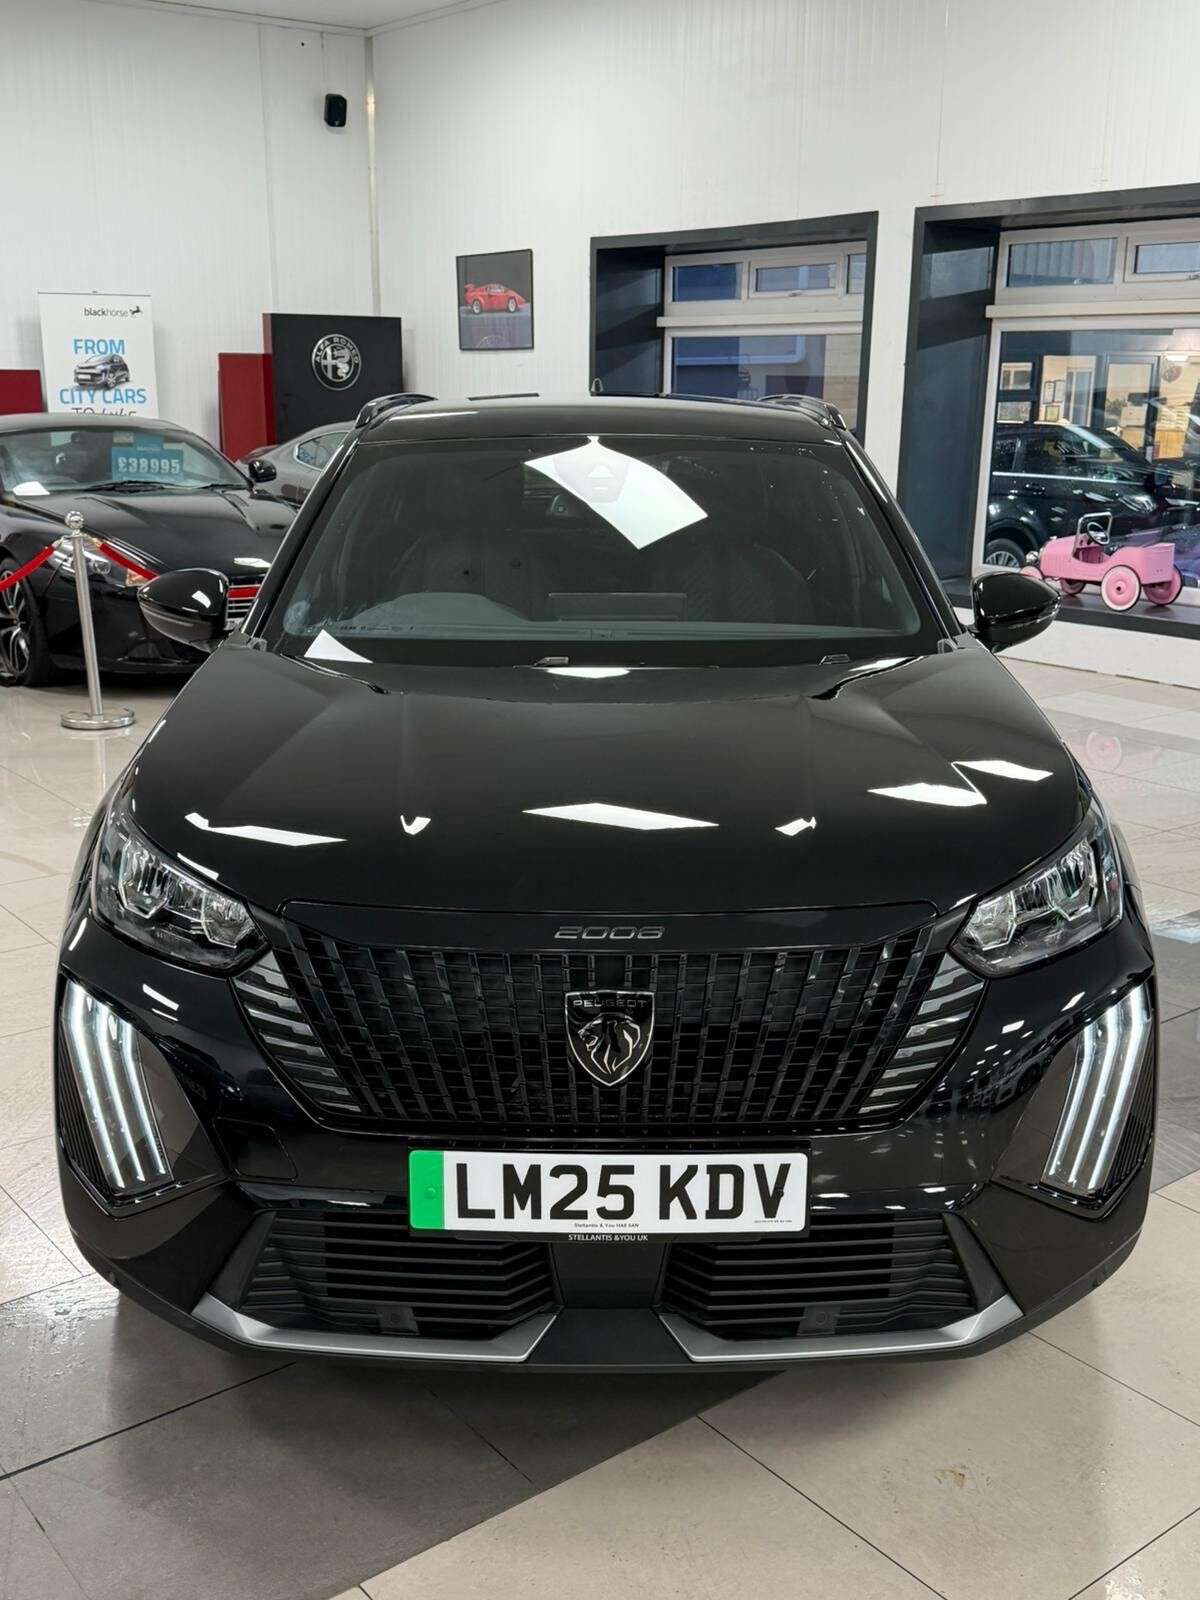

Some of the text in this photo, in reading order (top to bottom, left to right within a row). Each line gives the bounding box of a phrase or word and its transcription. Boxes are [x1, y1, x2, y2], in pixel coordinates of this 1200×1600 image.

[84, 307, 129, 317] blackhorse
[73, 339, 125, 355] FROM
[315, 336, 359, 364] ALFA ROMEO
[59, 388, 147, 404] CITY CARS
[554, 926, 665, 939] 2008
[573, 999, 647, 1008] PEUGEOT
[456, 1163, 791, 1220] LM25 KDV
